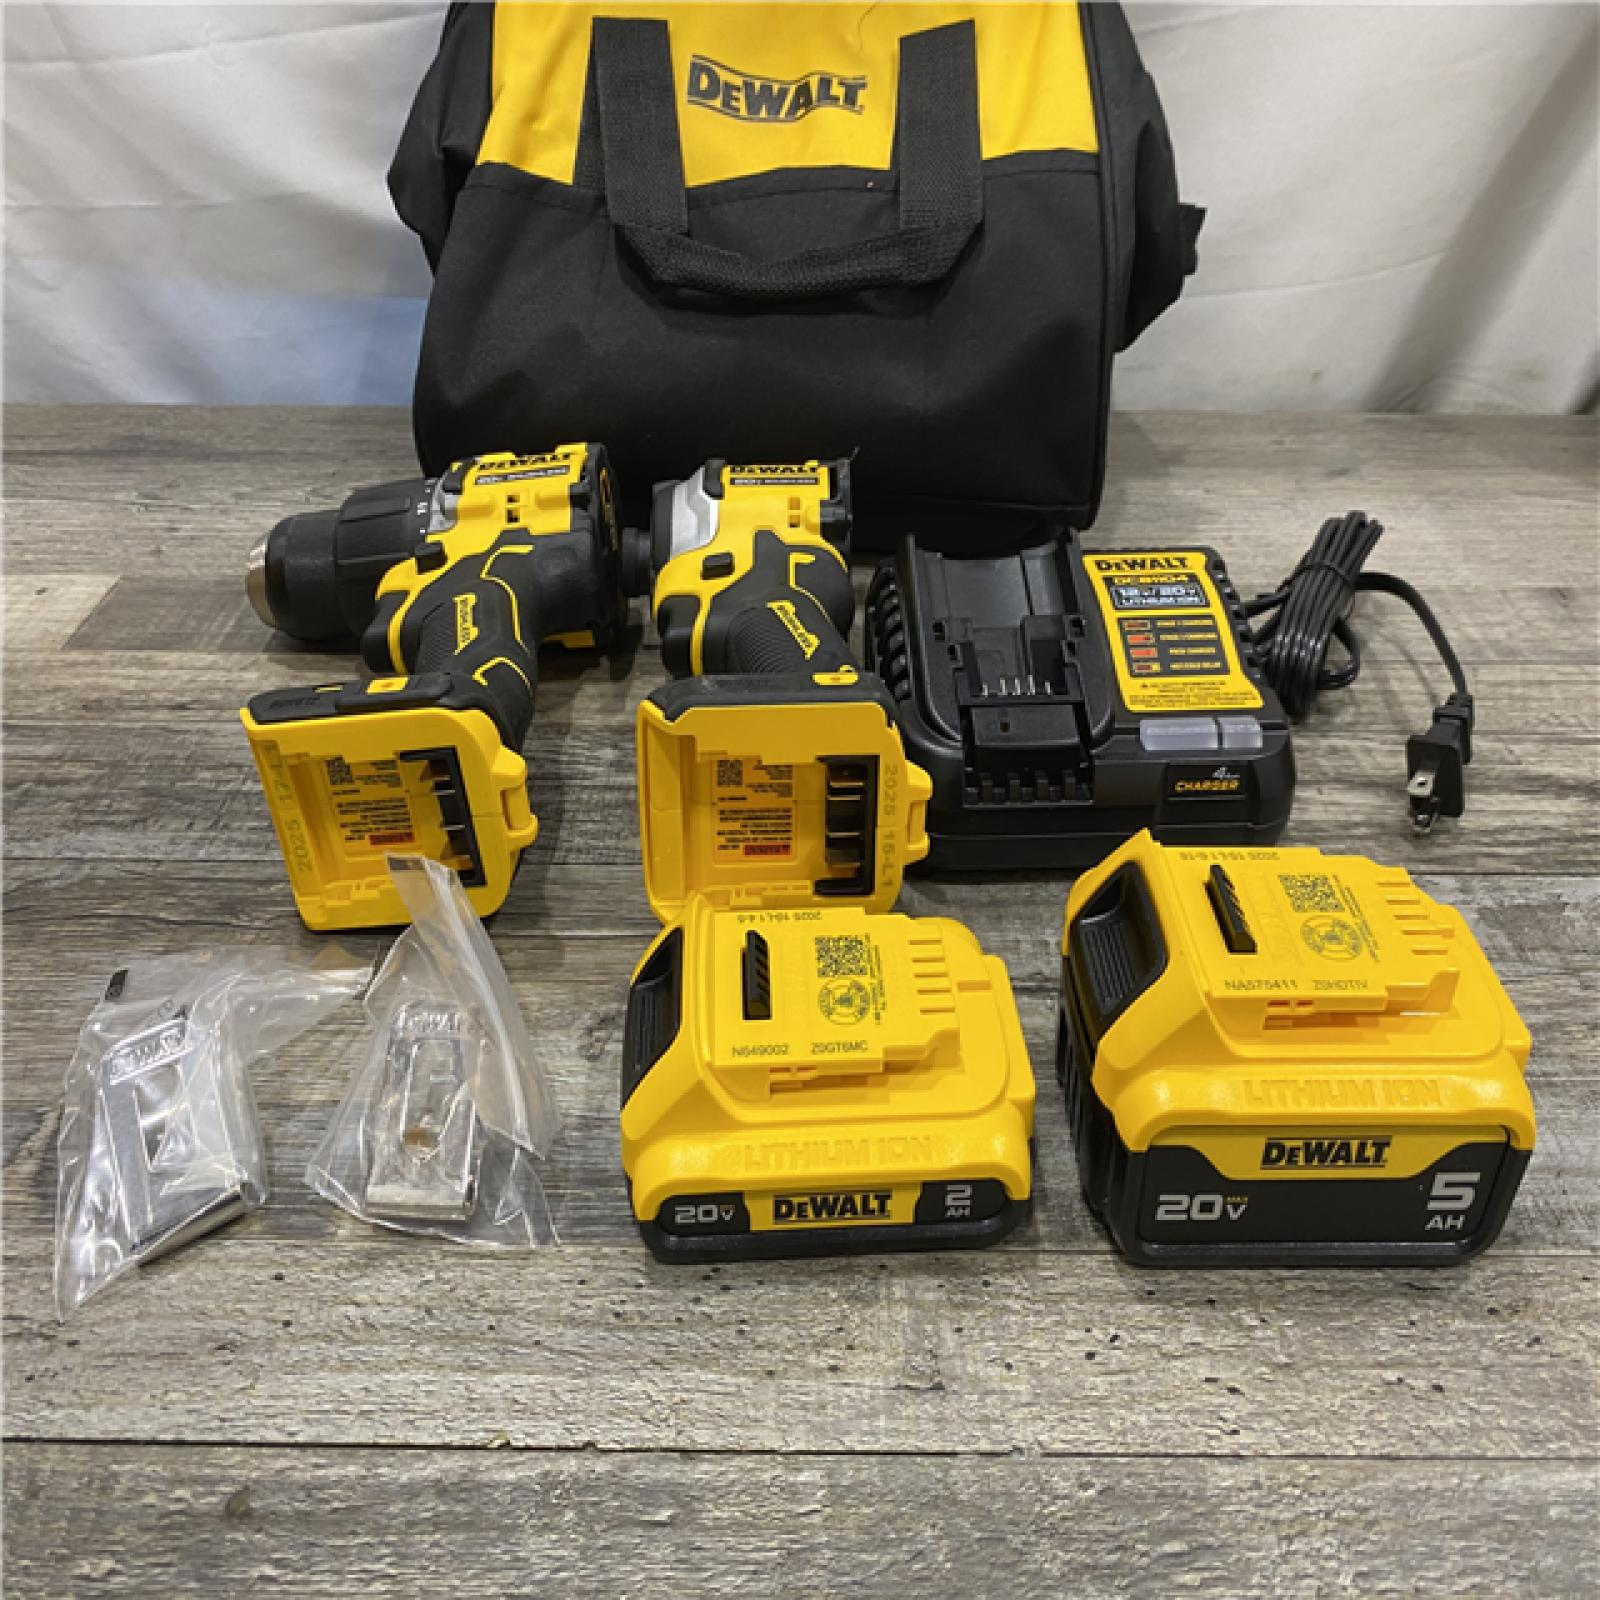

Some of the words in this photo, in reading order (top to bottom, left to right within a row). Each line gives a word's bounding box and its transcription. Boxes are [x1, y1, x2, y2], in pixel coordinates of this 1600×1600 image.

[687, 59, 867, 121] DEWALT
[1094, 556, 1189, 571] DEWALT
[1242, 1078, 1378, 1108] LITHIUM
[1381, 1078, 1443, 1107] ION
[744, 1138, 870, 1172] LITHIUM
[879, 1136, 931, 1165] ION
[1261, 1139, 1391, 1167] DEWALT
[944, 1184, 974, 1206] 2
[1426, 1172, 1481, 1211] 5
[774, 1193, 892, 1221] DEWALT
[1424, 1214, 1466, 1231] AH
